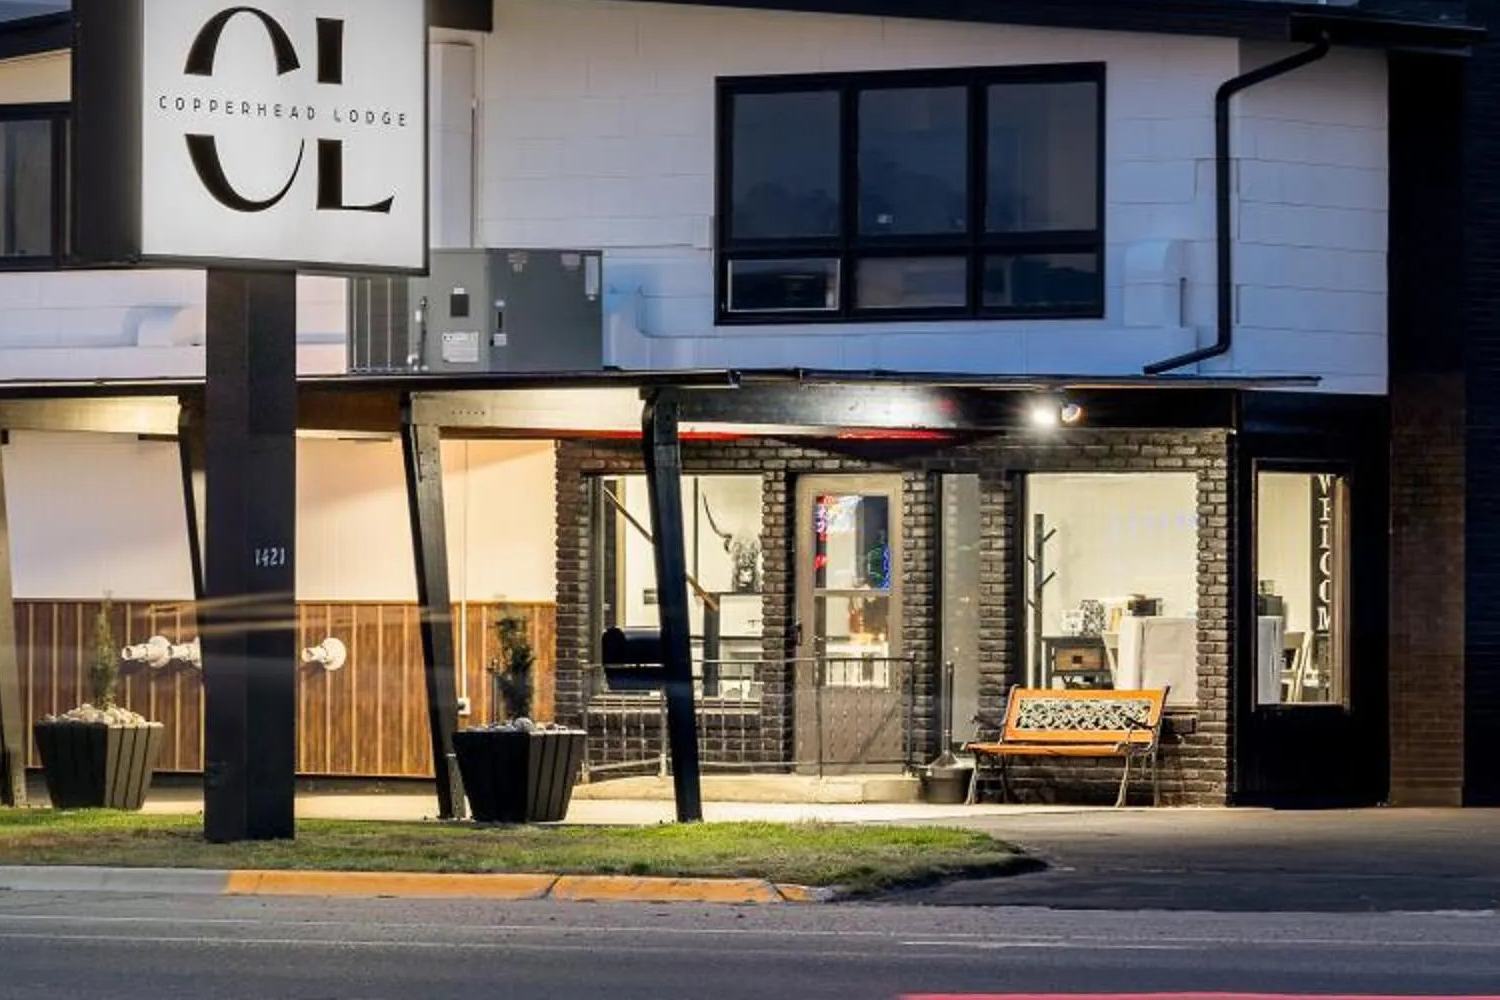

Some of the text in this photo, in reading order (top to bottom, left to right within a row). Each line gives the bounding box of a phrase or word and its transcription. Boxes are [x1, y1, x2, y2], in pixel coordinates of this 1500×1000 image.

[159, 95, 405, 127] COPPERHEAD LODGE
[254, 547, 285, 567] 1421
